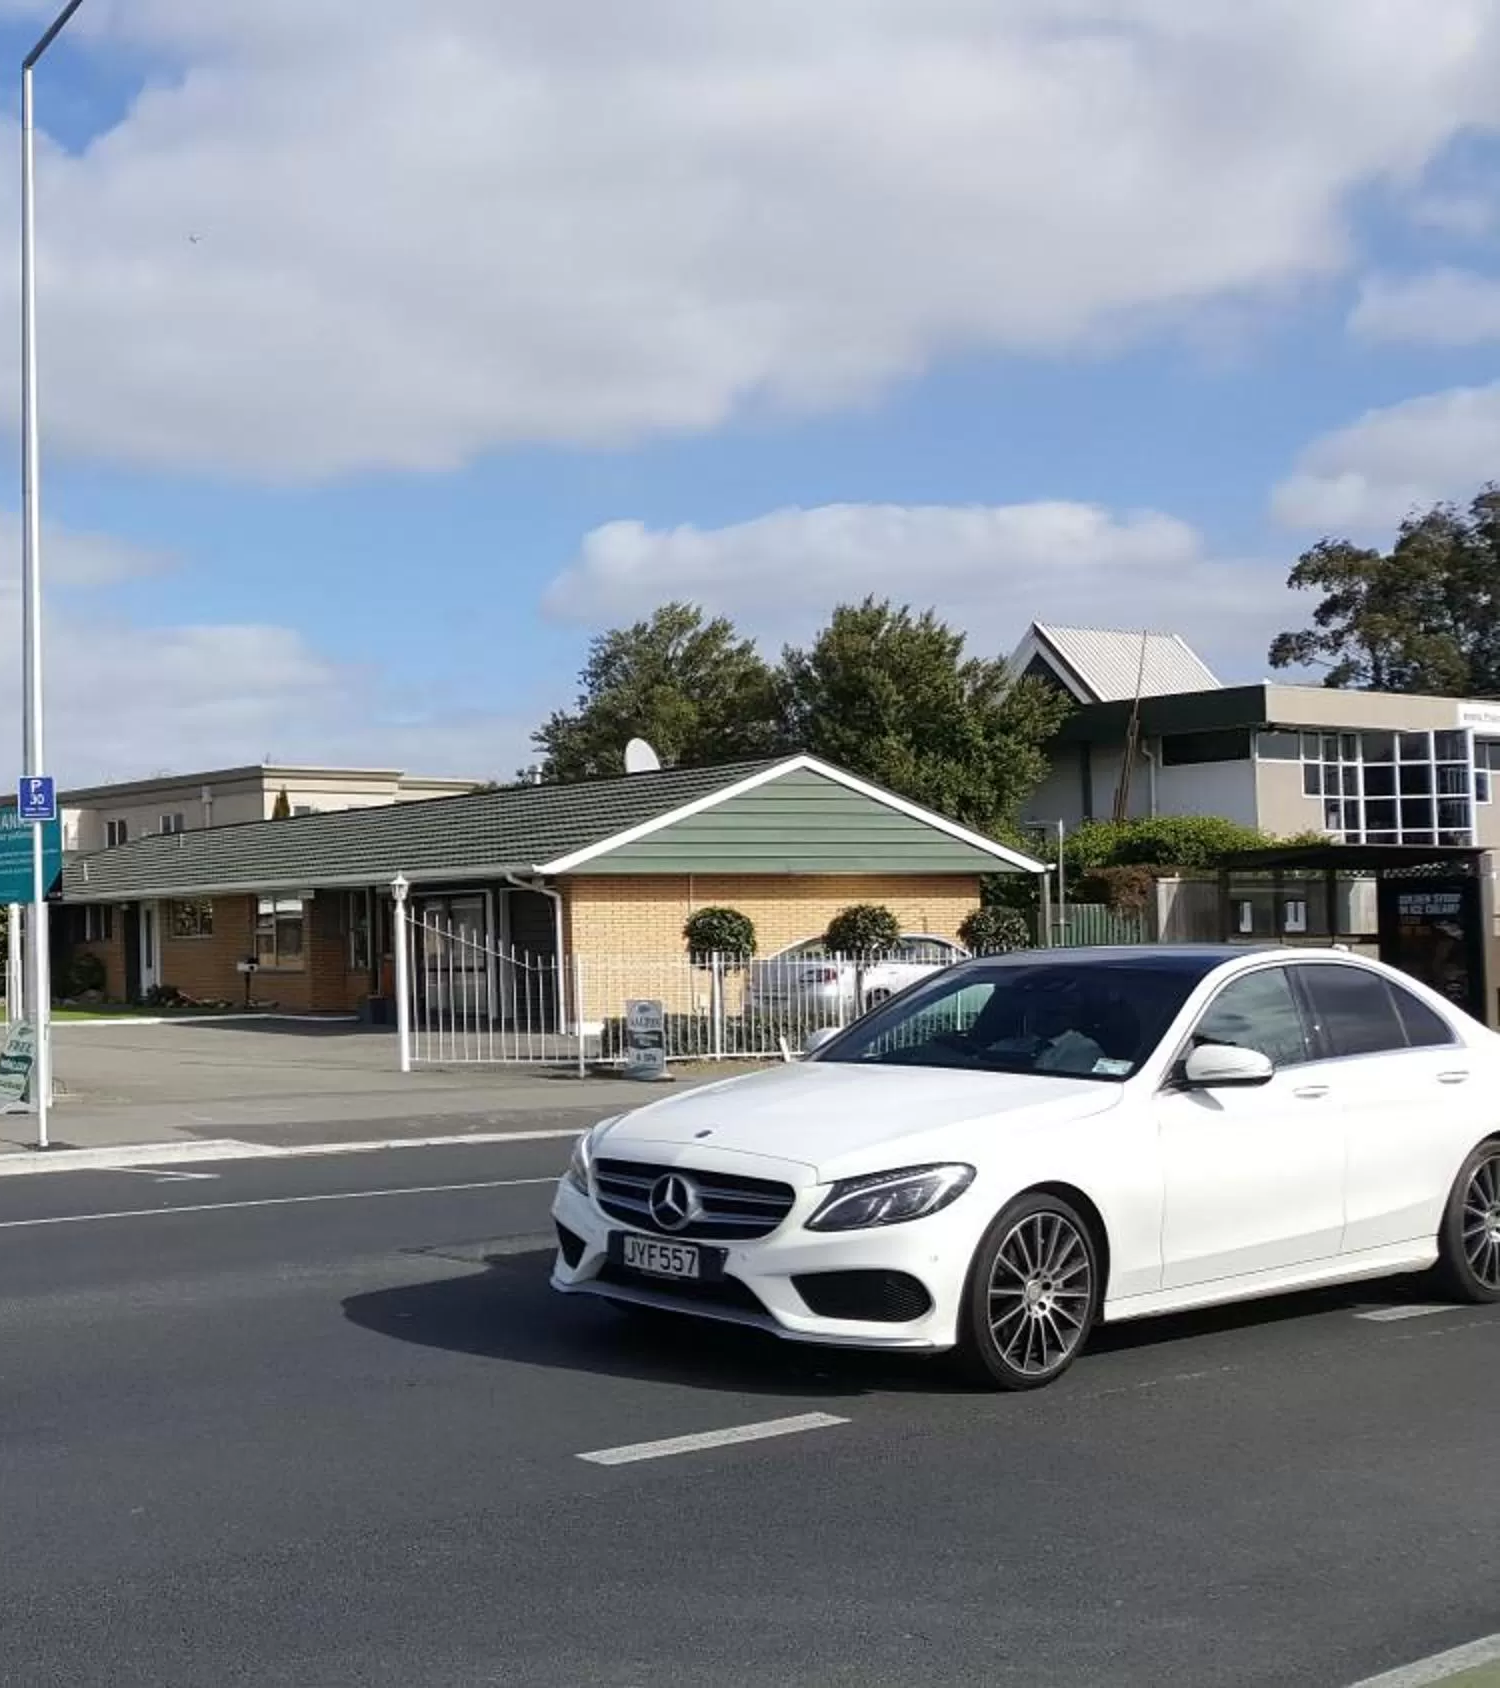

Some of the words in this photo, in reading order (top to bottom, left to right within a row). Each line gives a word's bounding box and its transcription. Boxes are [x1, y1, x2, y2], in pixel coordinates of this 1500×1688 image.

[30, 779, 42, 793] P
[29, 793, 45, 805] 30
[627, 1240, 697, 1274] JYF557
